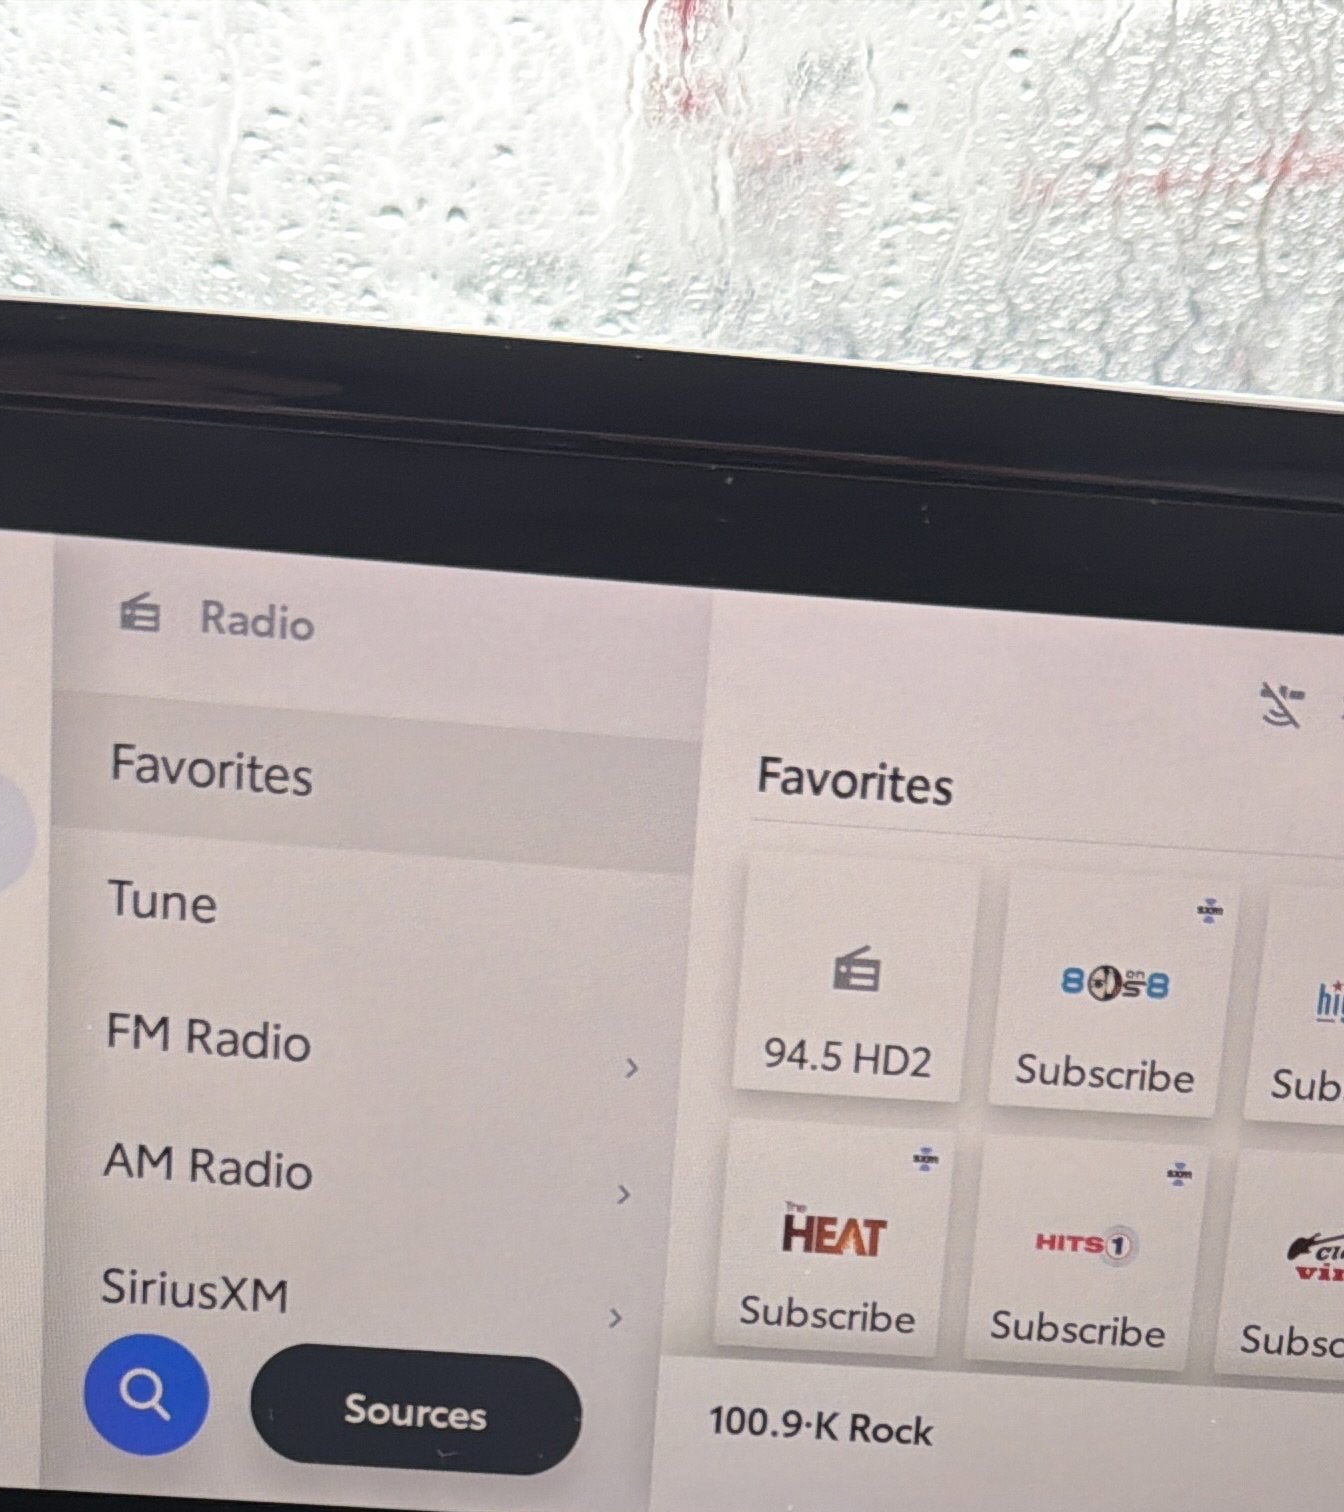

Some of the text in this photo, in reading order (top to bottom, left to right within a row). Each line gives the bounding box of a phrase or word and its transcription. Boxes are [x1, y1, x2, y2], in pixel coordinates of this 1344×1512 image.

[201, 599, 315, 642] Radio
[112, 743, 313, 797] Favorites
[758, 755, 953, 806] Favorites
[107, 878, 217, 924] Tune
[108, 1012, 311, 1063] FM Radio
[764, 1037, 932, 1078] 94.5 HD2
[1015, 1053, 1195, 1094] Subscribe
[103, 1142, 313, 1191] AM Radio
[782, 1214, 888, 1257] HEAT
[1035, 1232, 1106, 1254] HITS
[101, 1267, 288, 1314] SiriusXM
[740, 1295, 916, 1334] Subscribe
[990, 1310, 1166, 1349] Subscribe
[344, 1392, 487, 1431] Sources
[849, 1413, 934, 1447] Rock
